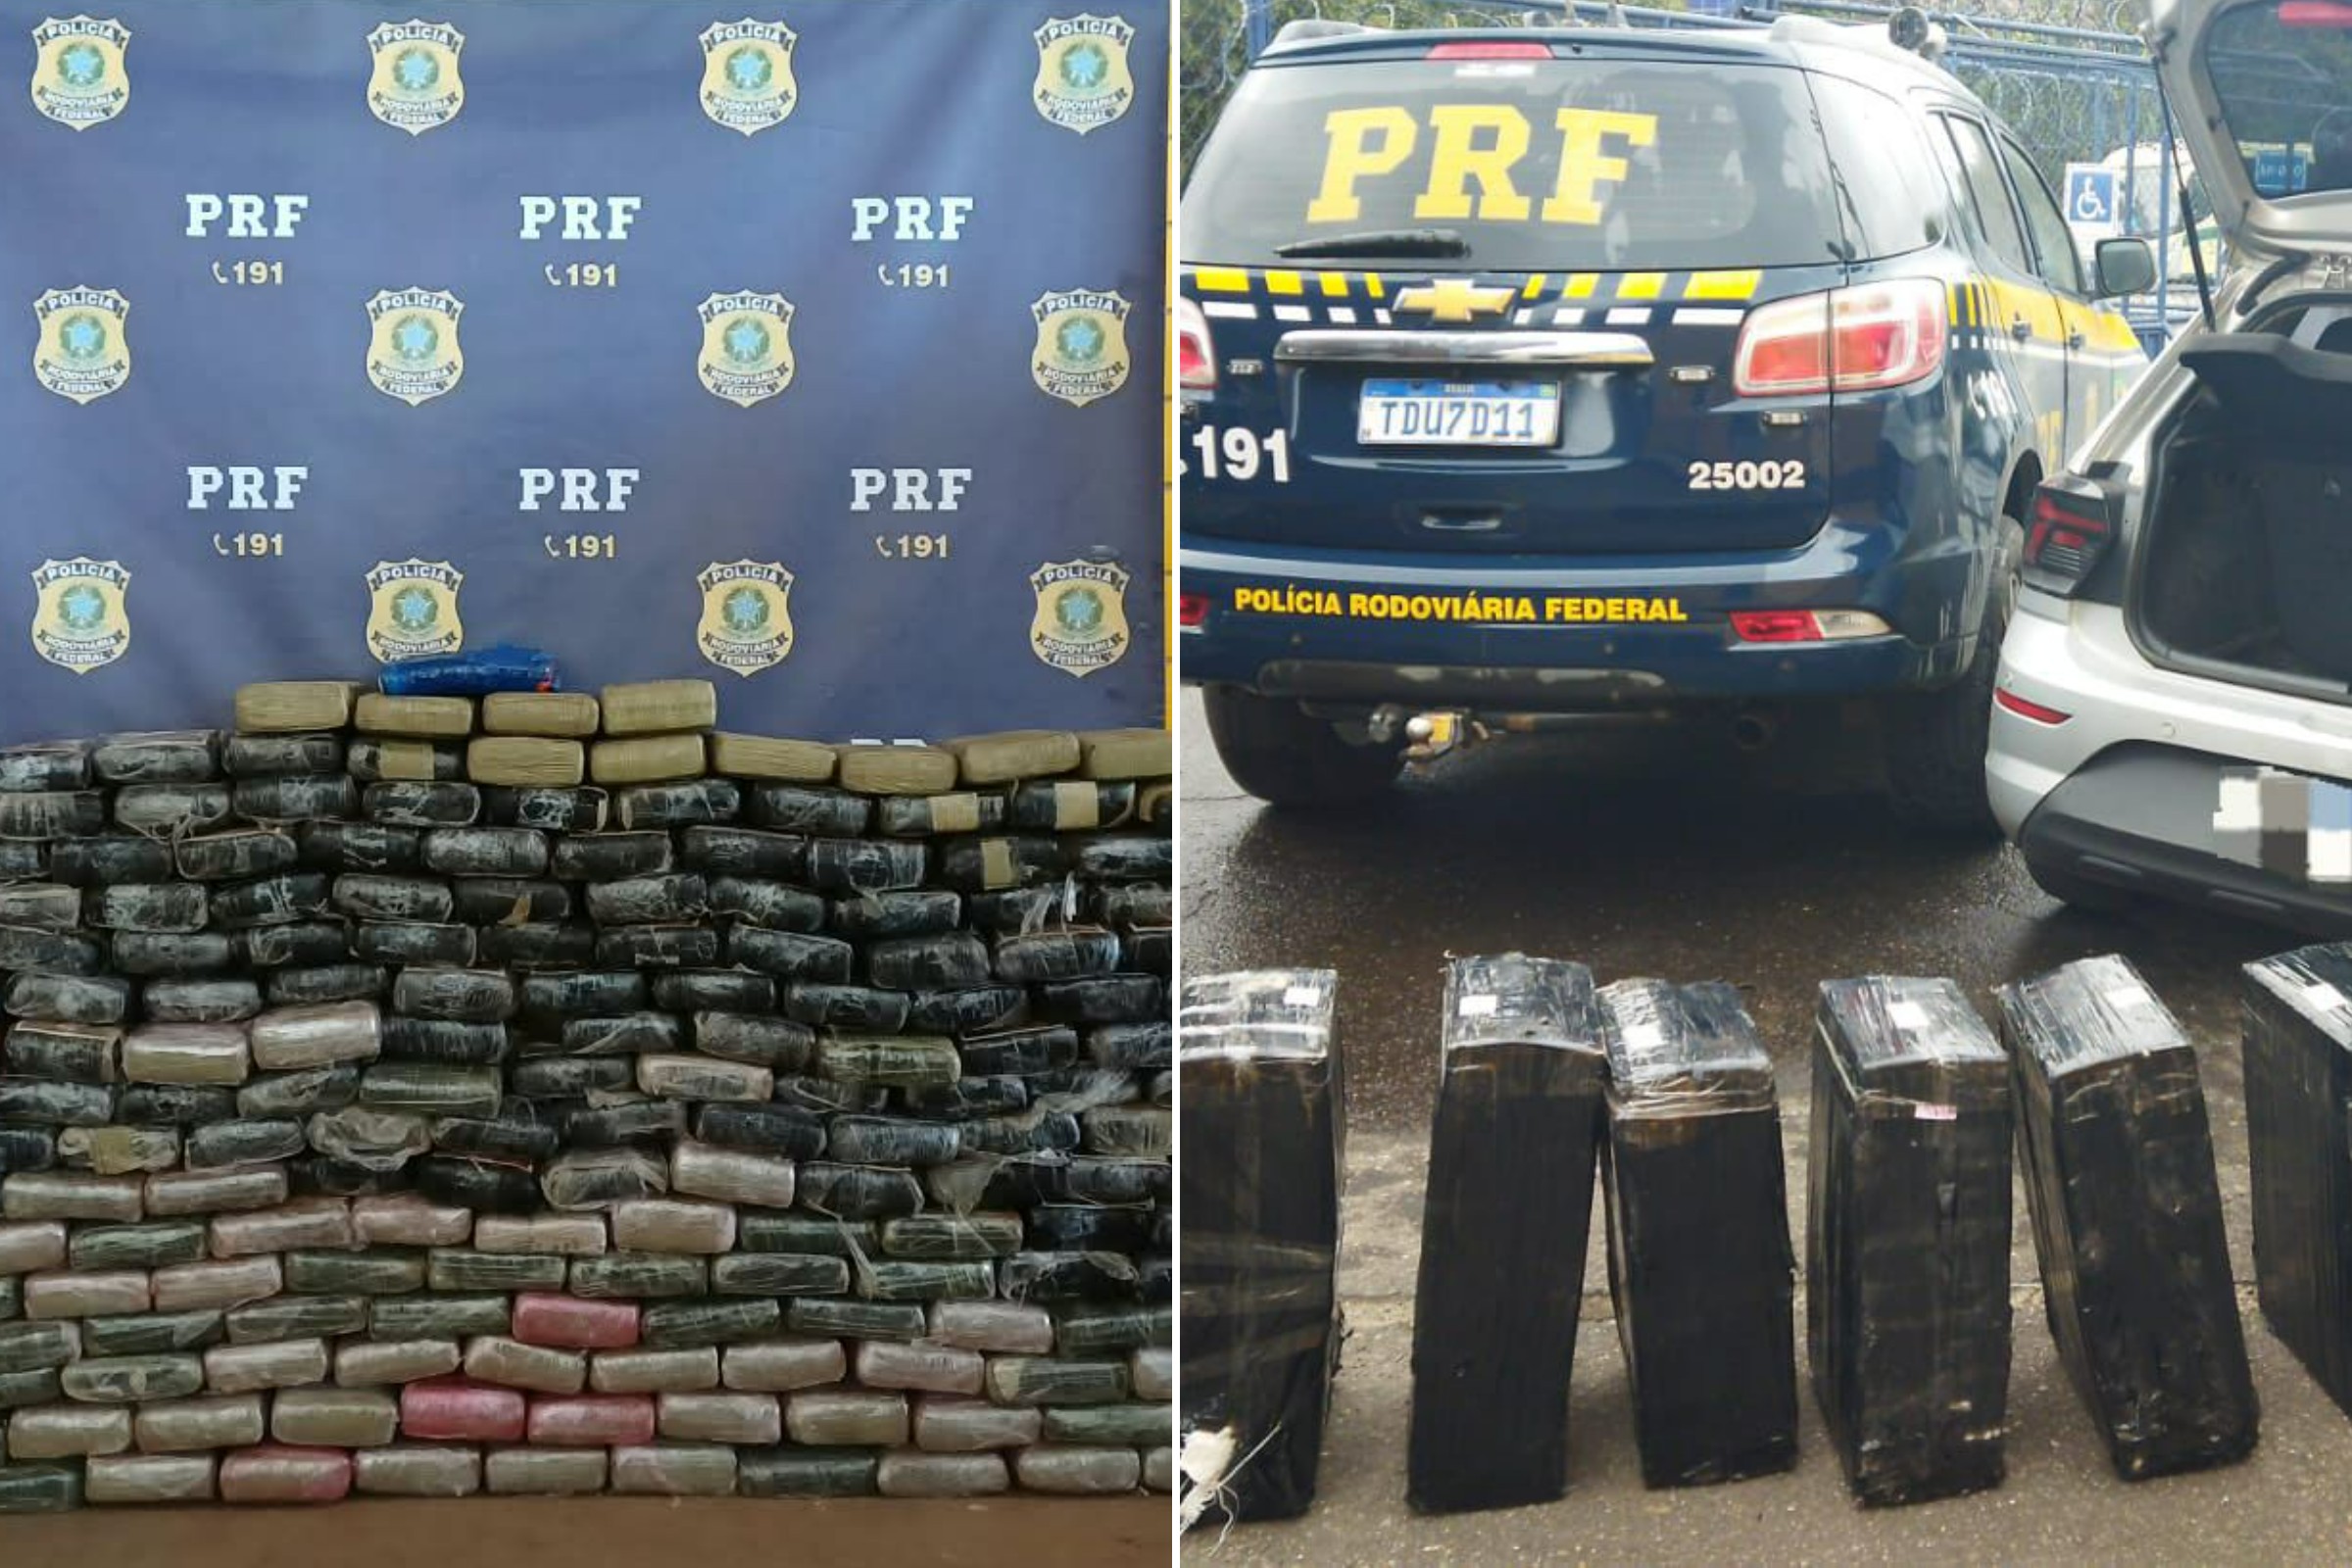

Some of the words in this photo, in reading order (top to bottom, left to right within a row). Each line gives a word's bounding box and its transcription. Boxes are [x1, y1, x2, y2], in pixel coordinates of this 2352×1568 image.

[1306, 103, 1658, 225] PRF
[186, 194, 309, 237] PRF
[520, 196, 642, 240] PRF
[851, 196, 973, 241] PRF
[232, 262, 284, 284] 191
[566, 264, 617, 286] 191
[899, 264, 949, 287] 191
[1380, 401, 1534, 437] TDU7D11
[1192, 424, 1289, 482] 191
[187, 466, 309, 510] PRF
[519, 468, 640, 511] PRF
[851, 468, 972, 511] PRF
[1689, 460, 1805, 489] 25002
[233, 533, 283, 556] 191
[565, 535, 616, 558] 191
[898, 535, 948, 558] 191
[1234, 583, 1344, 615] POLÍCIA
[1348, 588, 1537, 621] RODOVIÁRIA
[1544, 596, 1688, 621] FEDERAL
